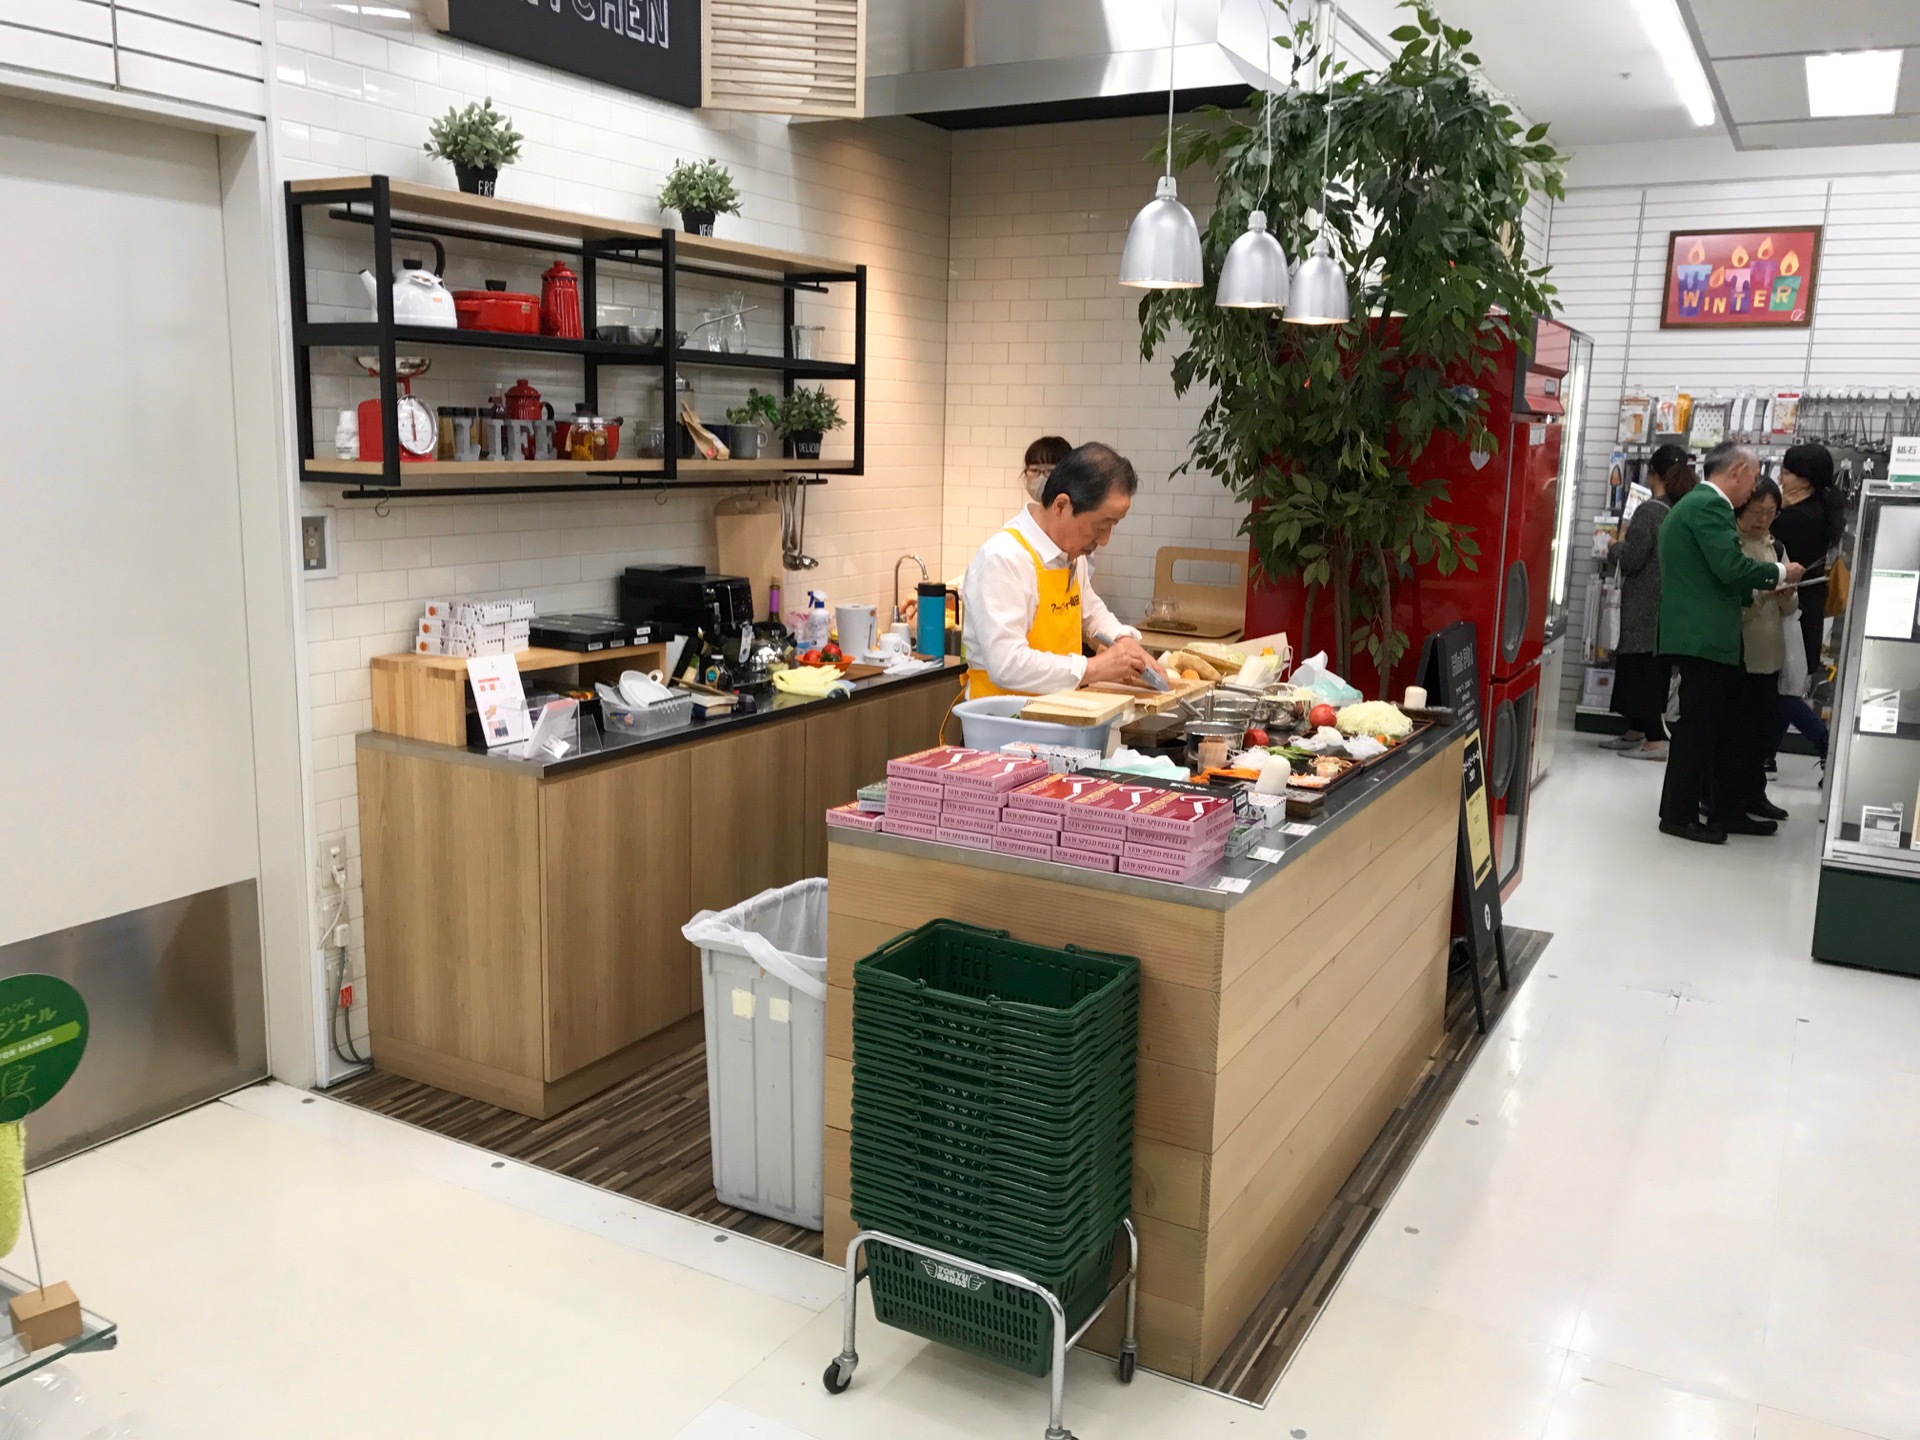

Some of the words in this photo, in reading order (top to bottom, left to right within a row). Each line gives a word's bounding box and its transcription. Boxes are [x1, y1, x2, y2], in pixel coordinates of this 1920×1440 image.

[1682, 285, 1792, 314] WINTER
[453, 418, 558, 462] LIFE
[0, 997, 34, 1017] ハンズ
[0, 1048, 17, 1061] OR
[18, 1035, 53, 1052] HANDS
[936, 1273, 967, 1288] HANDS
[938, 1265, 968, 1281] TOKYU
